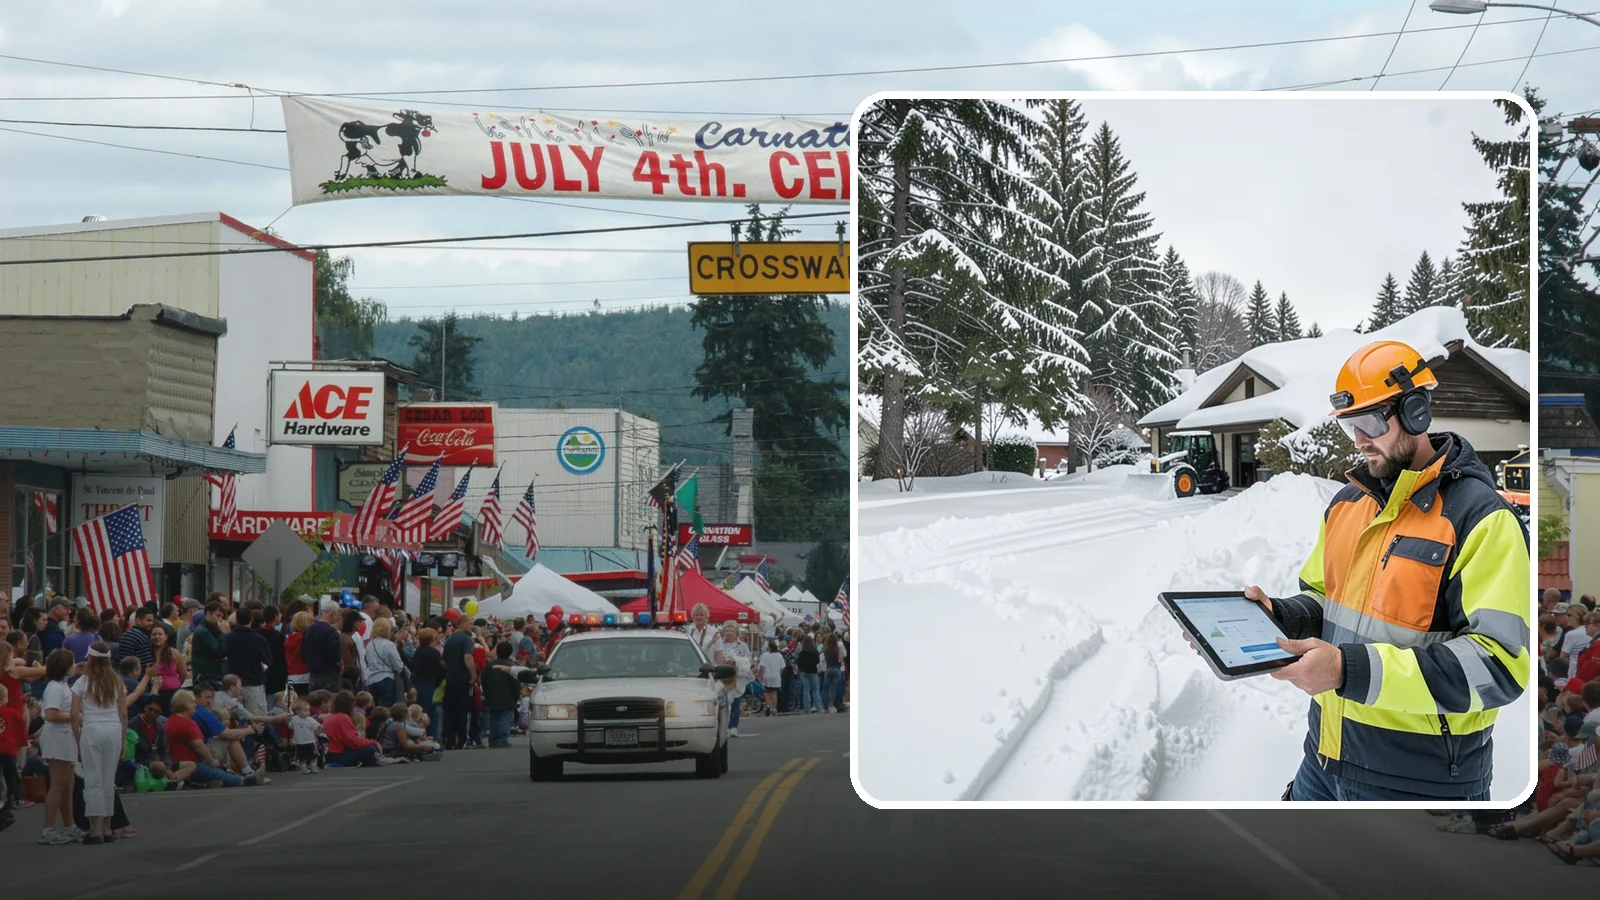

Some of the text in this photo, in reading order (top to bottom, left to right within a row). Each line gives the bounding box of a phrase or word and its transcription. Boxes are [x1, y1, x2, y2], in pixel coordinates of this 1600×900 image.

[695, 121, 850, 149] Carnat
[481, 141, 604, 192] JULY
[632, 150, 746, 198] 4th.
[697, 254, 850, 280] CROSSWA
[283, 380, 373, 420] ACE
[406, 409, 453, 422] CEDAR
[284, 421, 370, 436] Hardware
[416, 428, 477, 447] Coca-Cola
[353, 467, 384, 481] Simpl
[96, 485, 124, 495] Vincent
[126, 486, 136, 495] de
[138, 486, 155, 495] Paul
[81, 503, 153, 522] THT
[212, 516, 330, 536] HARDARE
[688, 526, 741, 535] CRNATION
[699, 535, 730, 543] GLASS
